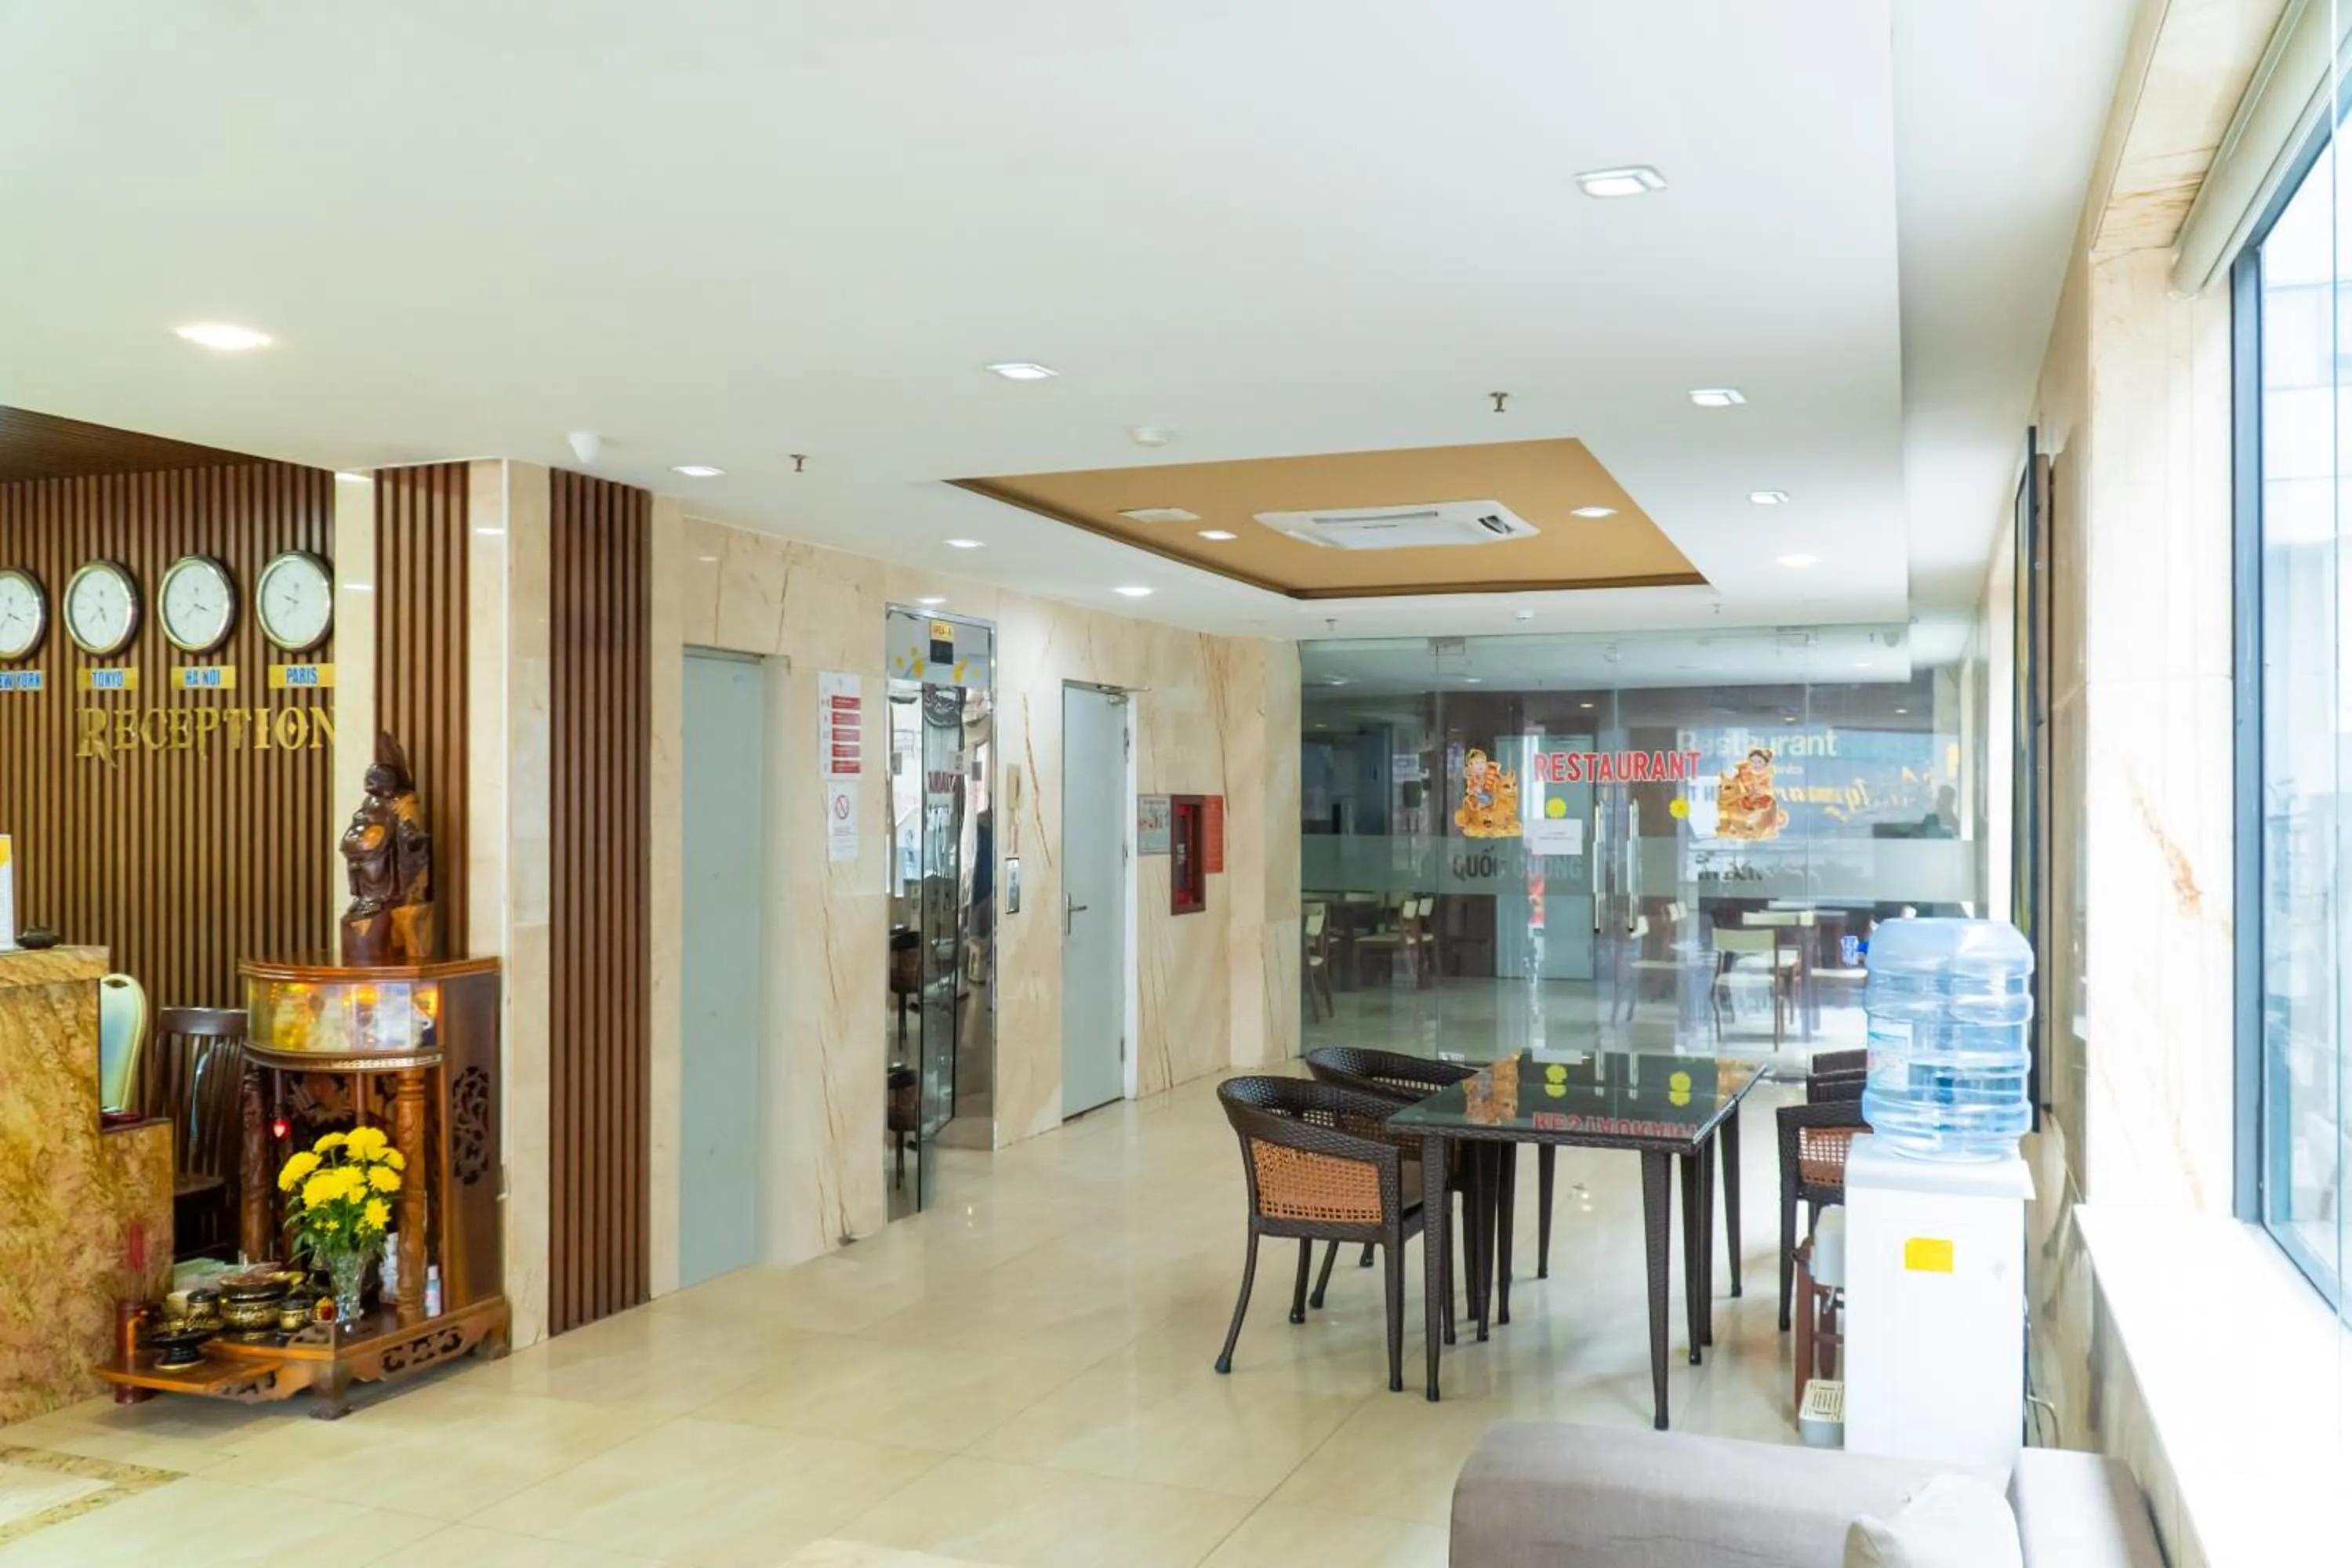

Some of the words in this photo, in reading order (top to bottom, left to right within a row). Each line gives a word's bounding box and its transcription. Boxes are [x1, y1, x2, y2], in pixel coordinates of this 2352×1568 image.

[17, 671, 41, 688] YORK
[93, 670, 124, 688] TOKYO
[185, 669, 198, 685] HA
[201, 669, 220, 685] NOI
[286, 666, 318, 684] PARIS
[76, 706, 335, 768] RECEPTION
[1677, 727, 1838, 757] Restaurant
[1533, 750, 1701, 783] RESTAURANT
